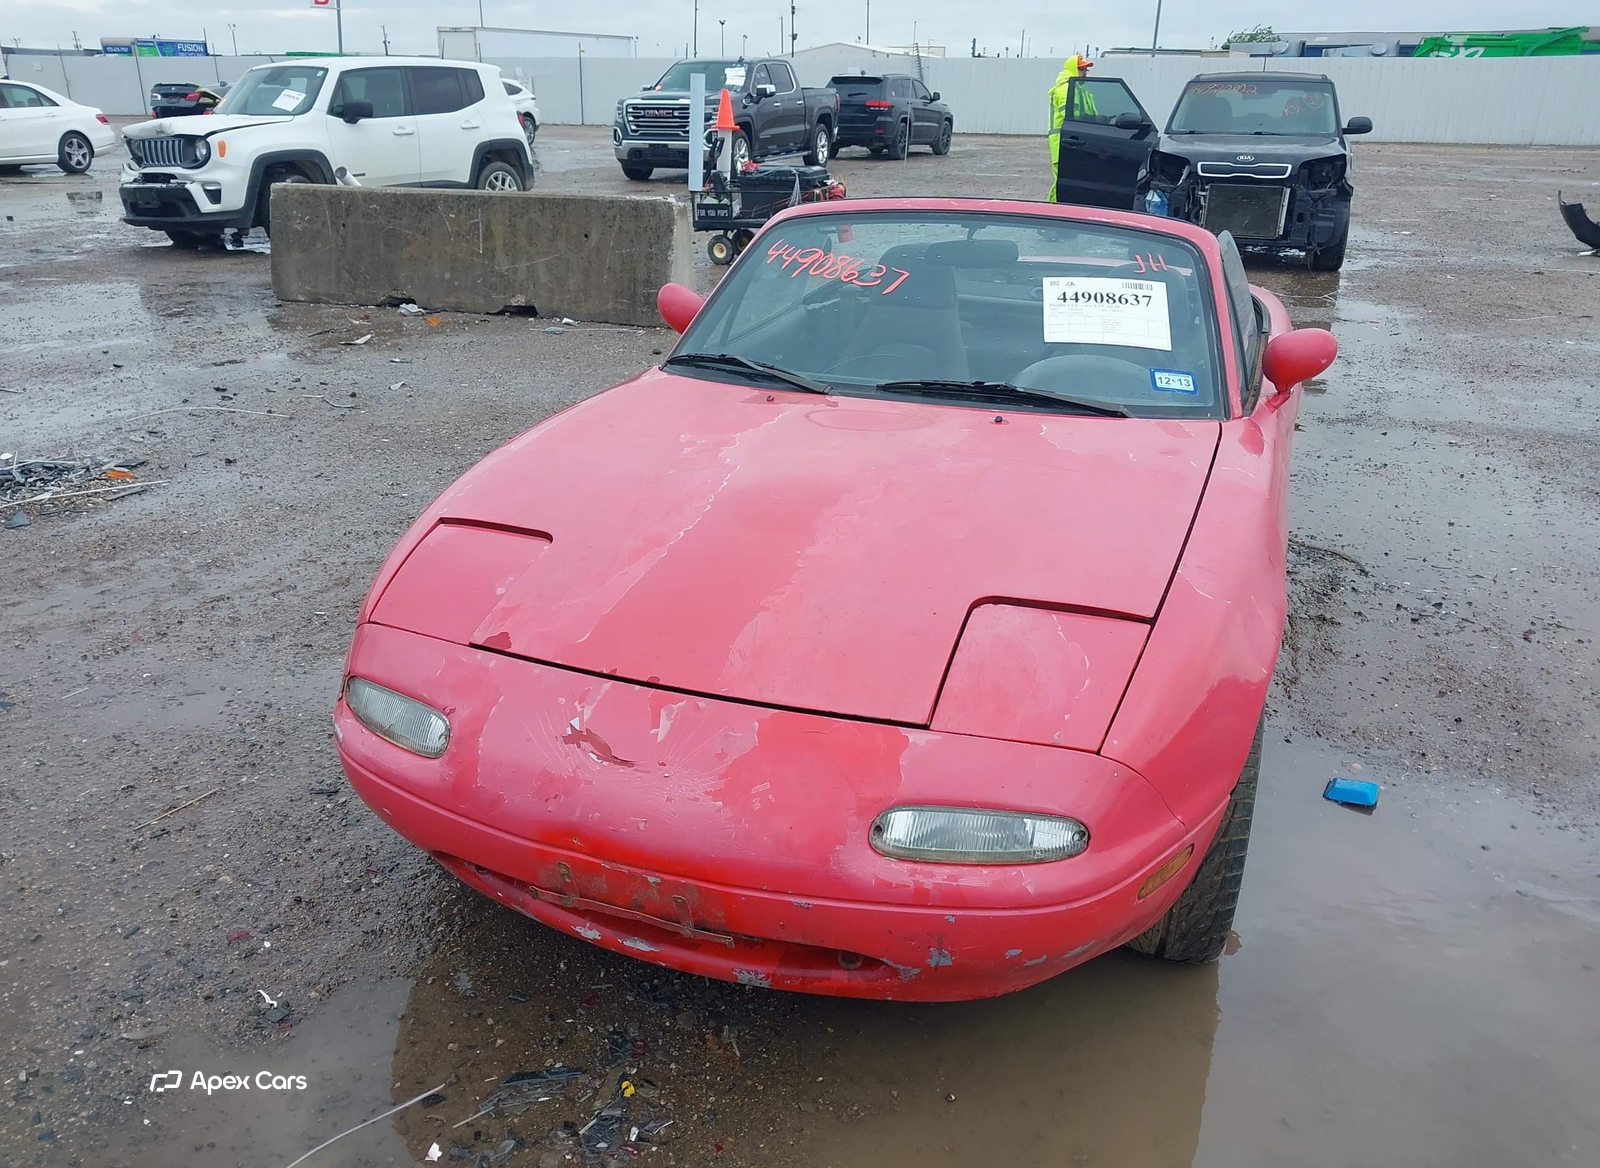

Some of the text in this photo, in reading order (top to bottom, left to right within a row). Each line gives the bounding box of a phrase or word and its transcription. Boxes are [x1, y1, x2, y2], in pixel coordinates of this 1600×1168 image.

[177, 43, 204, 52] FUSION
[644, 109, 673, 117] GMC
[766, 238, 910, 294] 44908637
[1057, 291, 1153, 308] 44908637
